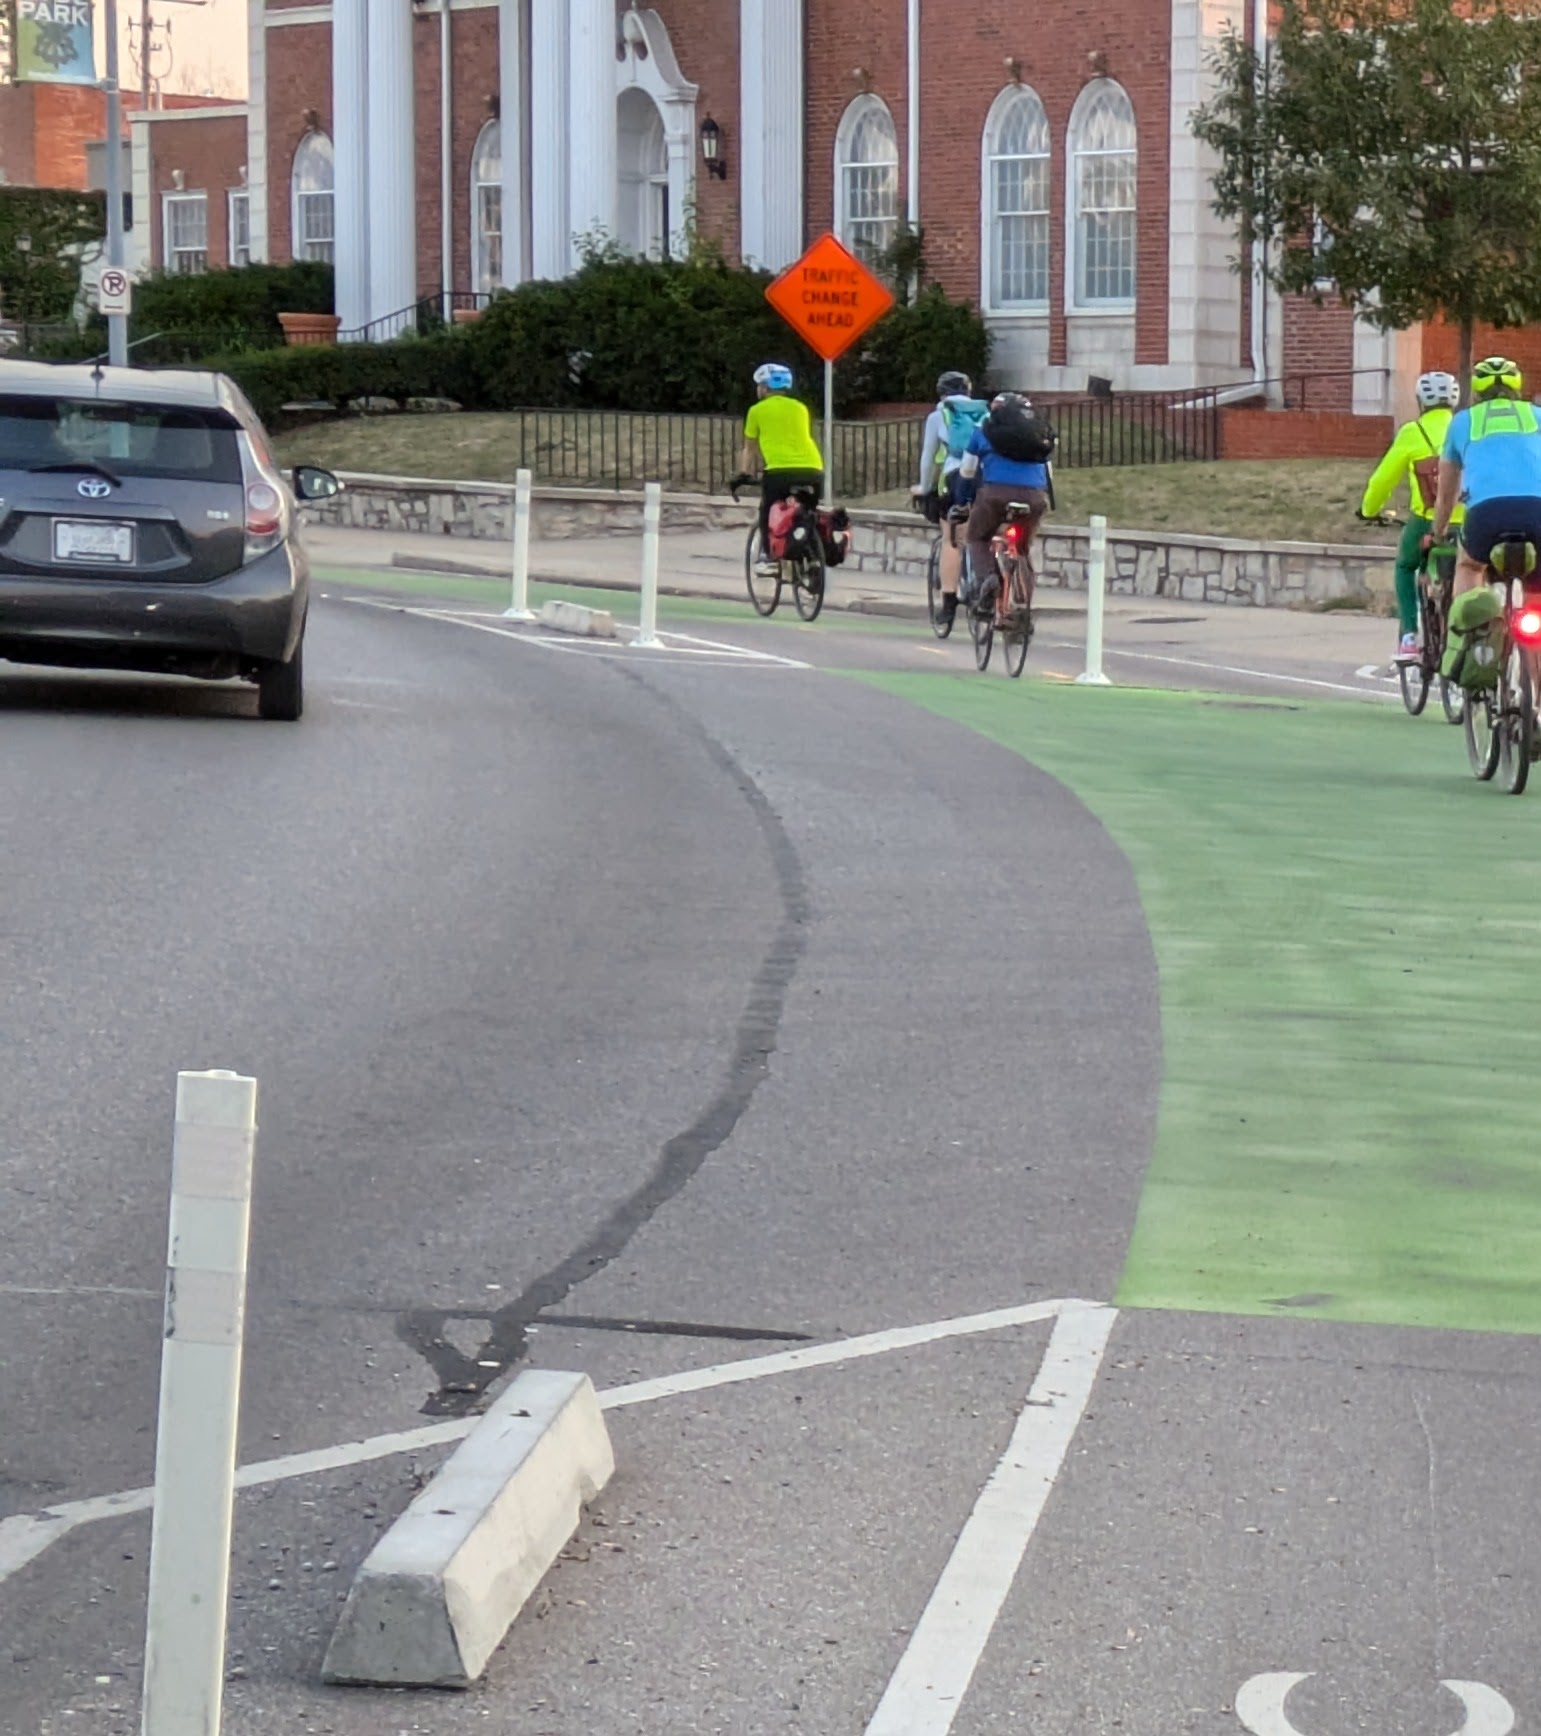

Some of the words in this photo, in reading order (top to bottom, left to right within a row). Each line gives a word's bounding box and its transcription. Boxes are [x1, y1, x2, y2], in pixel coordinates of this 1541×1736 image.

[18, 1, 89, 27] PARK
[803, 267, 859, 285] TRAFFIC
[802, 290, 858, 307] CHANGE
[807, 312, 855, 328] AHEAD
